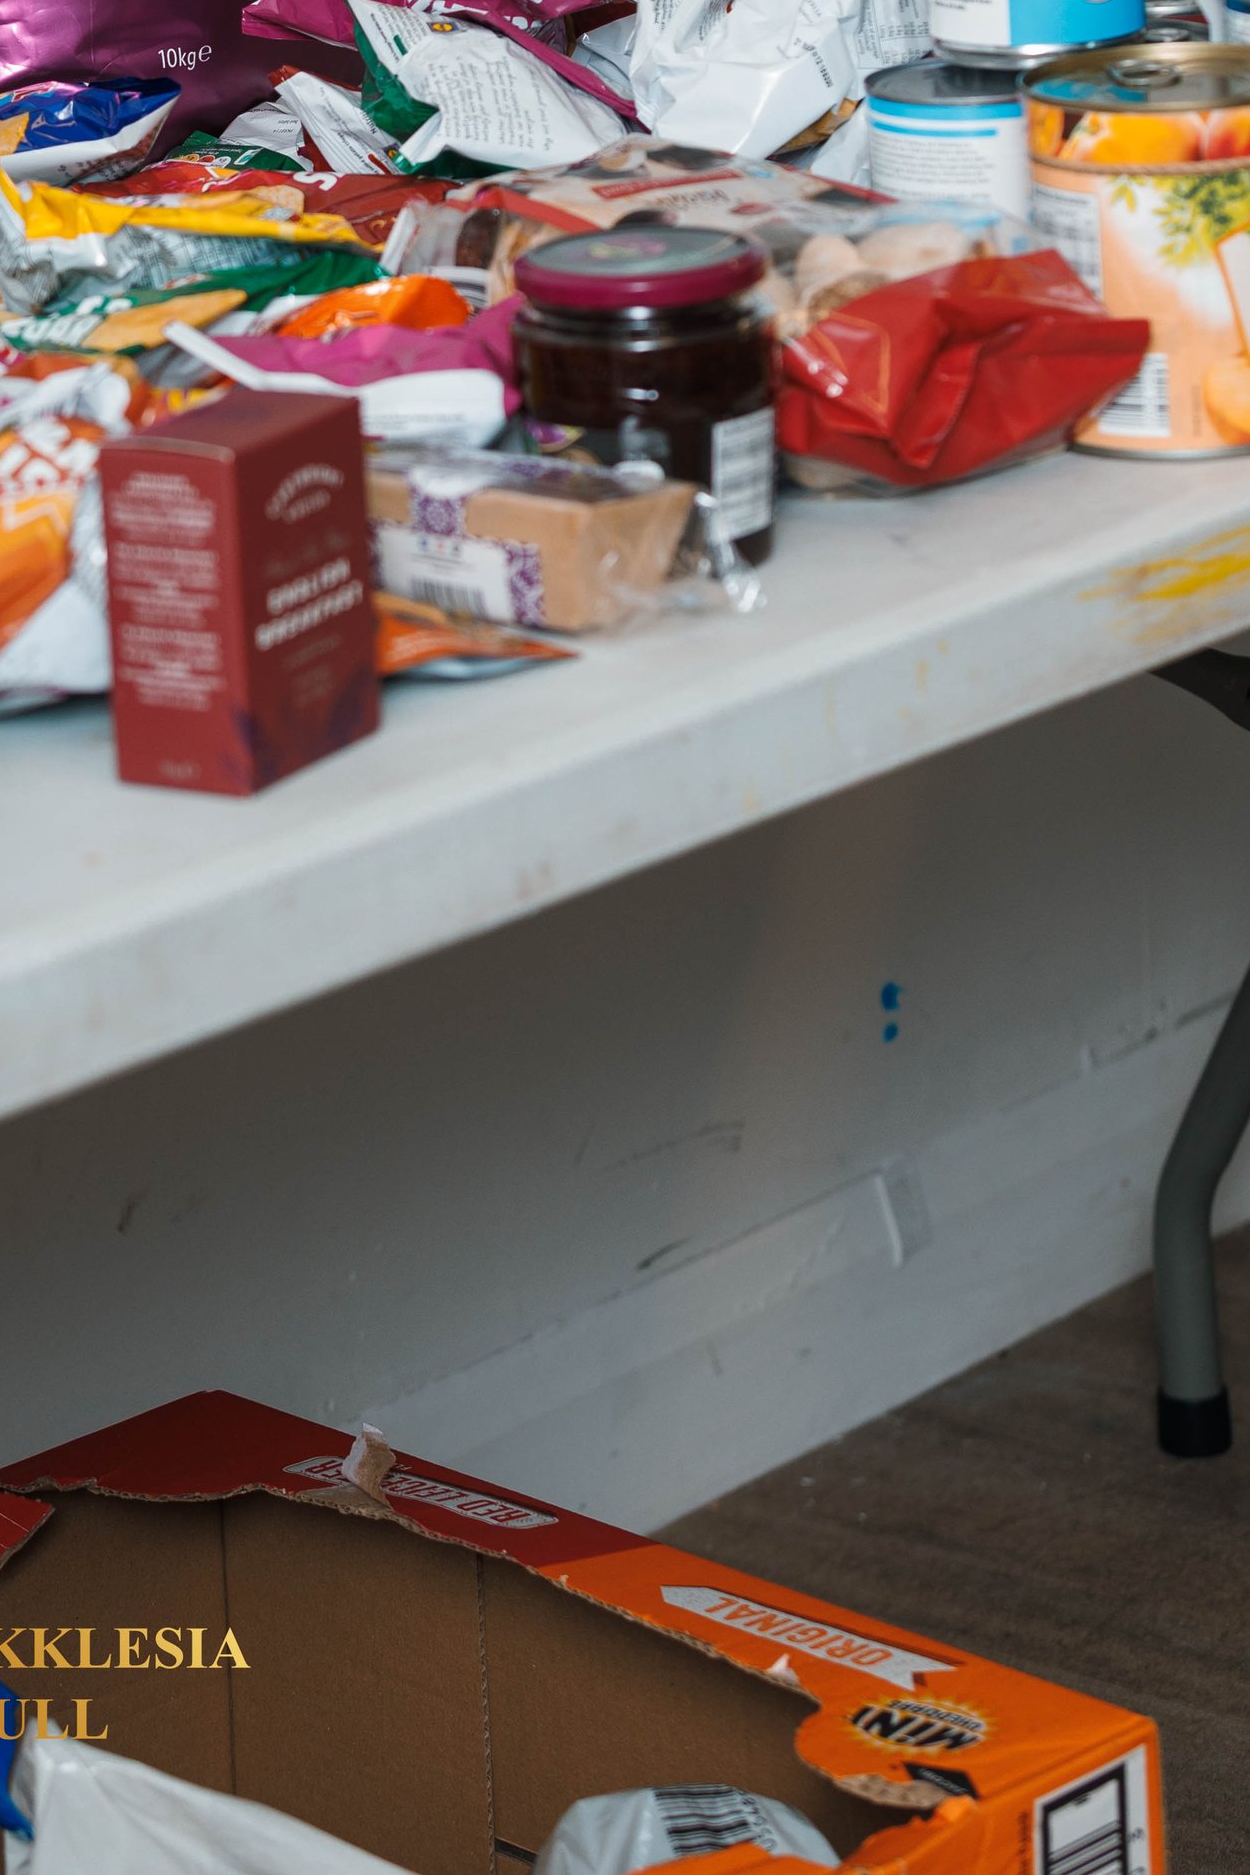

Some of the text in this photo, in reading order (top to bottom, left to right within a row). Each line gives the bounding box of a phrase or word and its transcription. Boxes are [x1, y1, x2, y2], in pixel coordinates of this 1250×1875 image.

[305, 1459, 532, 1523] RED LEICEER
[703, 1595, 895, 1668] ORIGINAL
[851, 1705, 983, 1750] MINI
